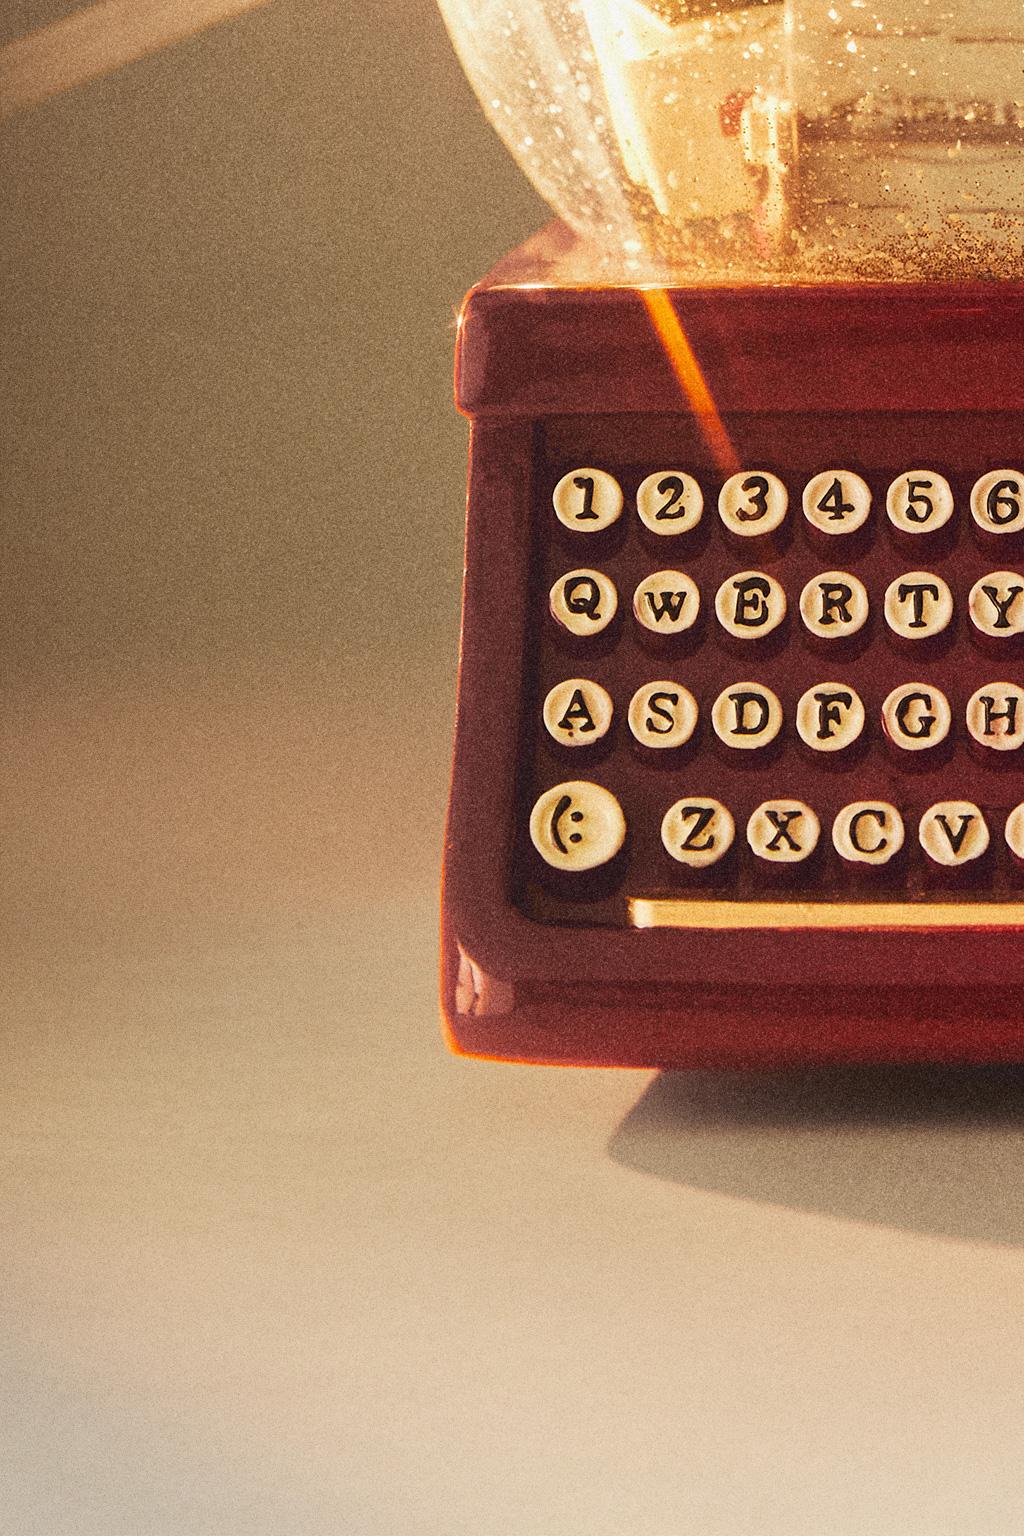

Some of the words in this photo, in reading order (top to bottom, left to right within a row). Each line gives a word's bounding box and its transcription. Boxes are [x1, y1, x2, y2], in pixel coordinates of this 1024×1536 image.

[571, 475, 601, 521] 1
[654, 474, 687, 522] 2
[734, 474, 771, 523] 3
[816, 477, 856, 522] 4
[904, 477, 935, 525] 5
[985, 478, 1021, 527] 6
[562, 574, 603, 622] Q
[731, 575, 772, 629] E
[817, 581, 854, 627] R
[896, 582, 941, 630] T
[980, 583, 1024, 630] Y
[556, 688, 597, 734] A
[644, 690, 681, 736] S
[727, 690, 771, 736] D
[812, 690, 854, 741] F
[894, 690, 938, 740] G
[978, 694, 1020, 737] H
[680, 805, 717, 853] Z
[764, 809, 804, 853] X
[848, 807, 889, 855] C
[933, 813, 976, 856] V
